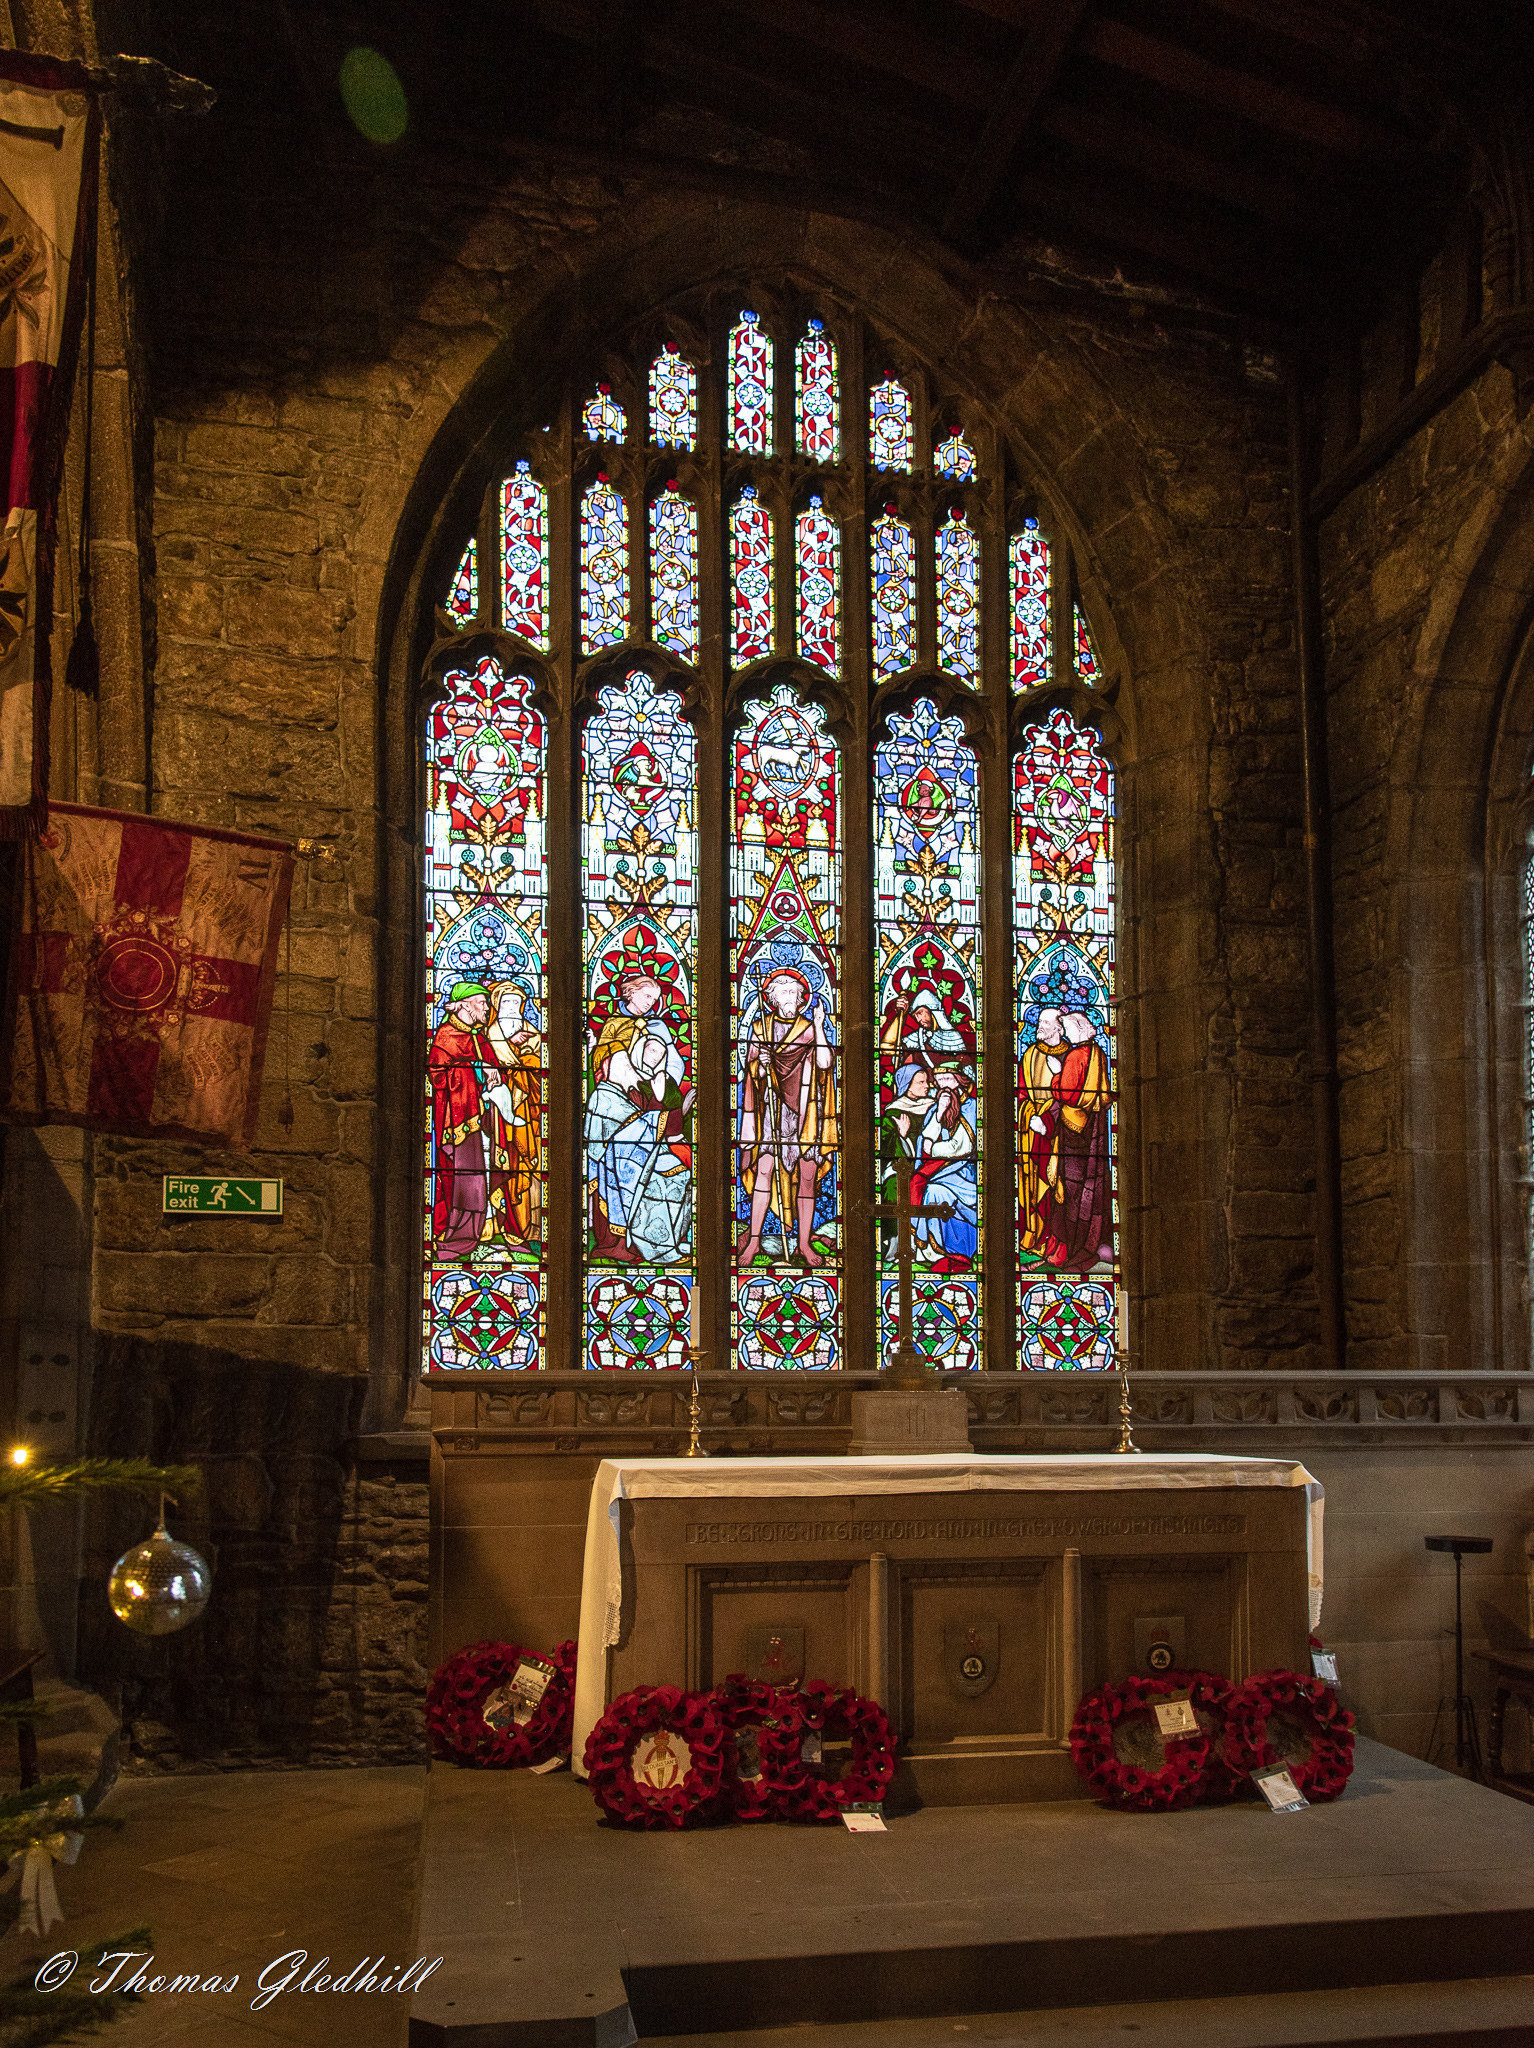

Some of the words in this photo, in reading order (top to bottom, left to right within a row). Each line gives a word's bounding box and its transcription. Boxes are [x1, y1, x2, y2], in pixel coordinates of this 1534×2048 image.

[169, 1180, 200, 1194] Fire
[169, 1196, 199, 1209] exit
[695, 1524, 720, 1543] BE
[728, 1522, 798, 1542] STRONG
[805, 1522, 827, 1541] IN
[835, 1522, 872, 1540] THE
[881, 1520, 926, 1539] LORD
[935, 1519, 974, 1538] AND
[1050, 1517, 1111, 1537] POWER
